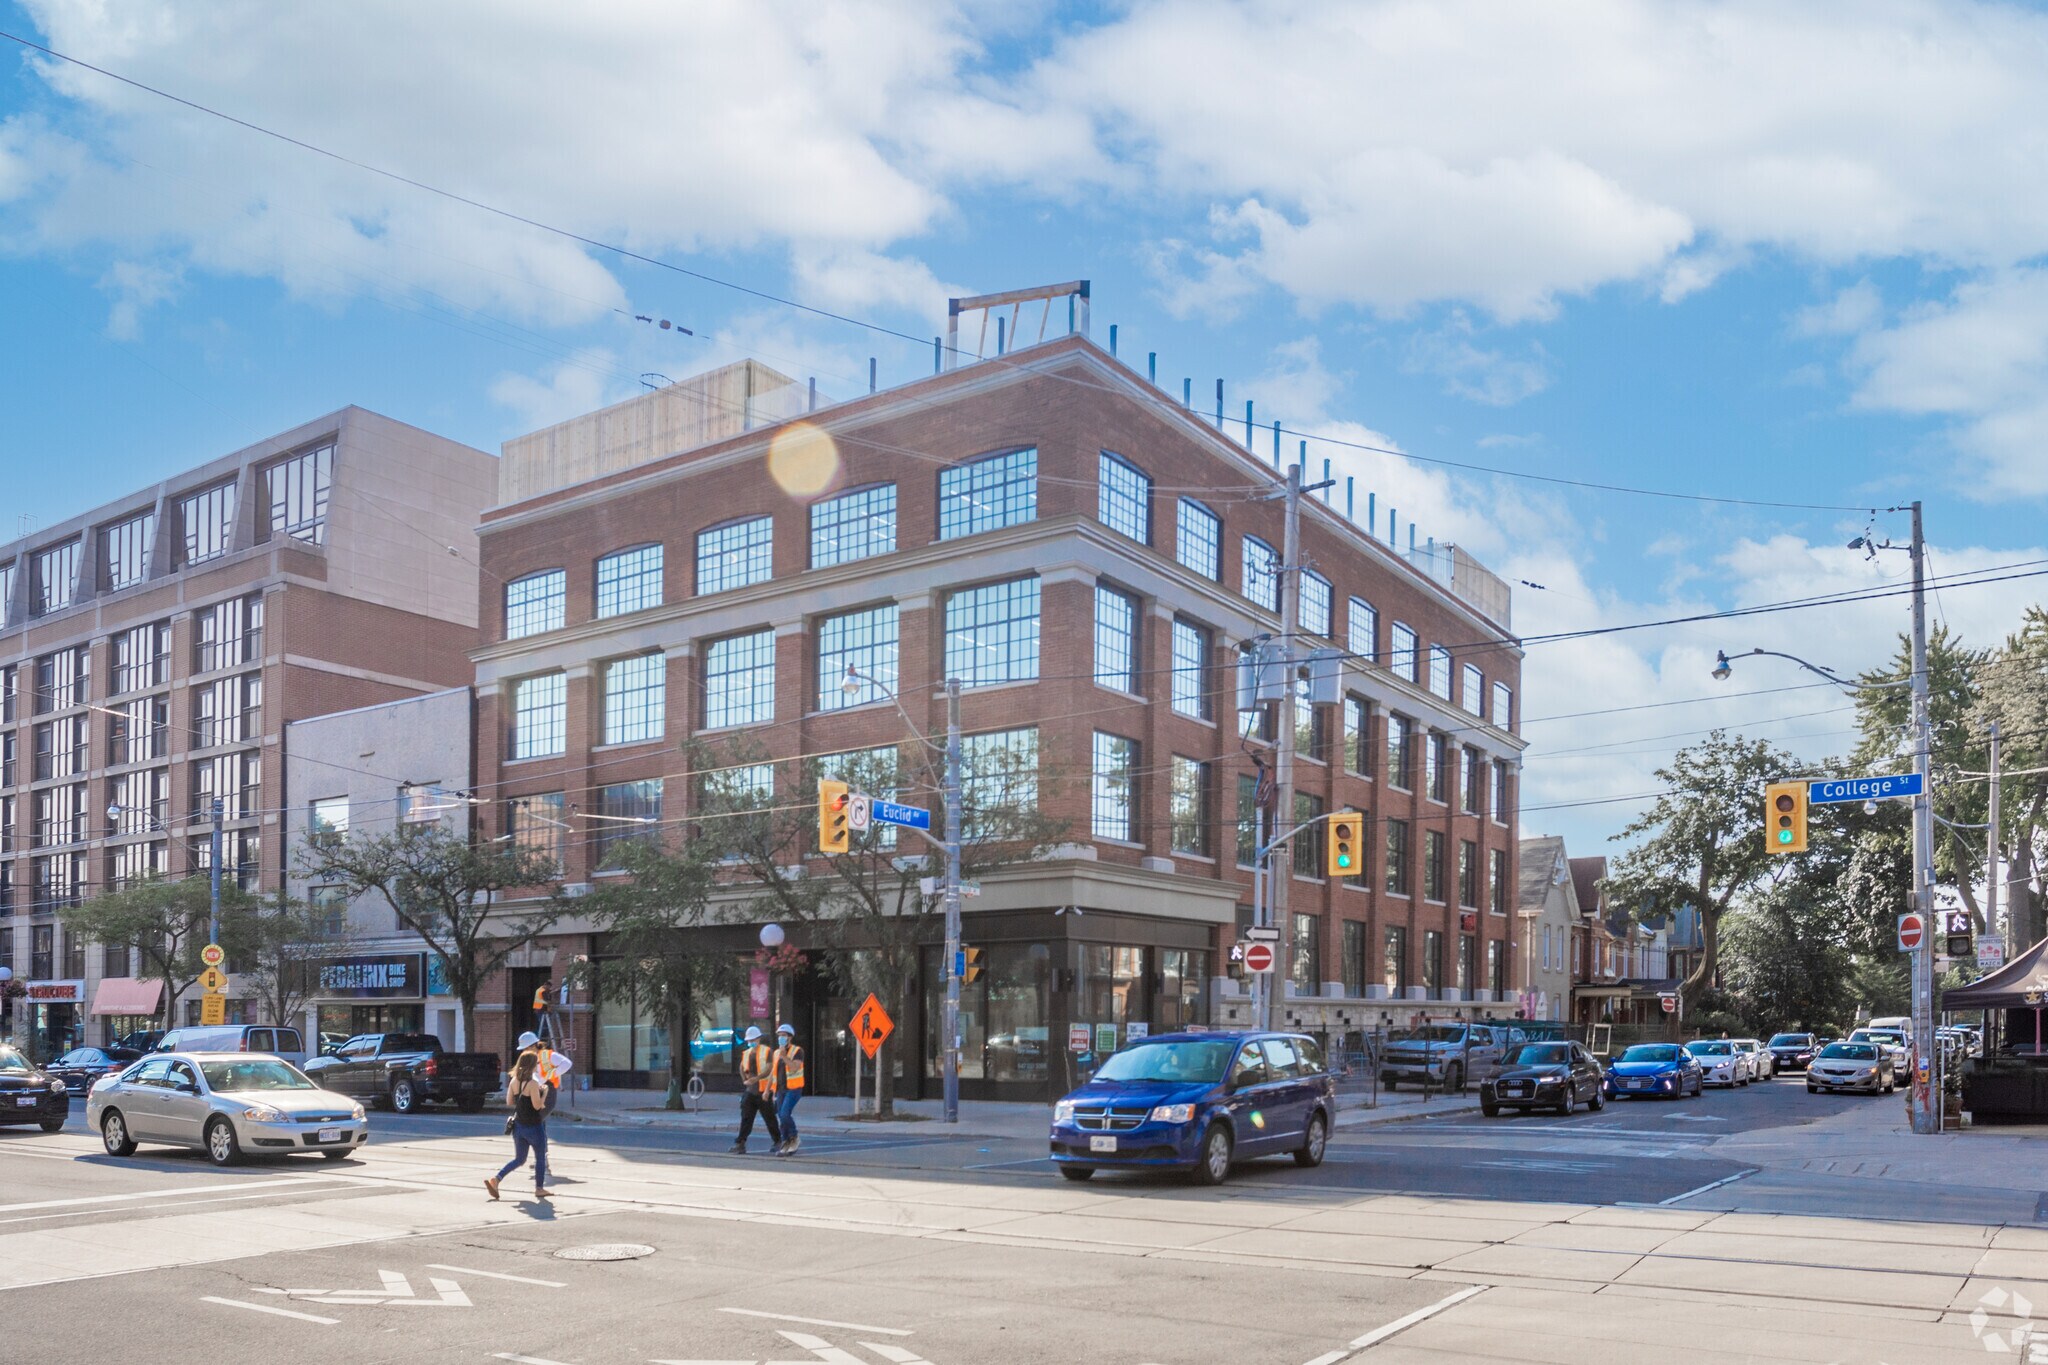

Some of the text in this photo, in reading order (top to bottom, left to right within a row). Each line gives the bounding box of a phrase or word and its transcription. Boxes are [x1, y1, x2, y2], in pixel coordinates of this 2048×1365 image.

[1823, 776, 1909, 797] College St
[883, 804, 912, 822] Euclid
[389, 963, 406, 976] BIKE
[388, 977, 406, 988] SHOP
